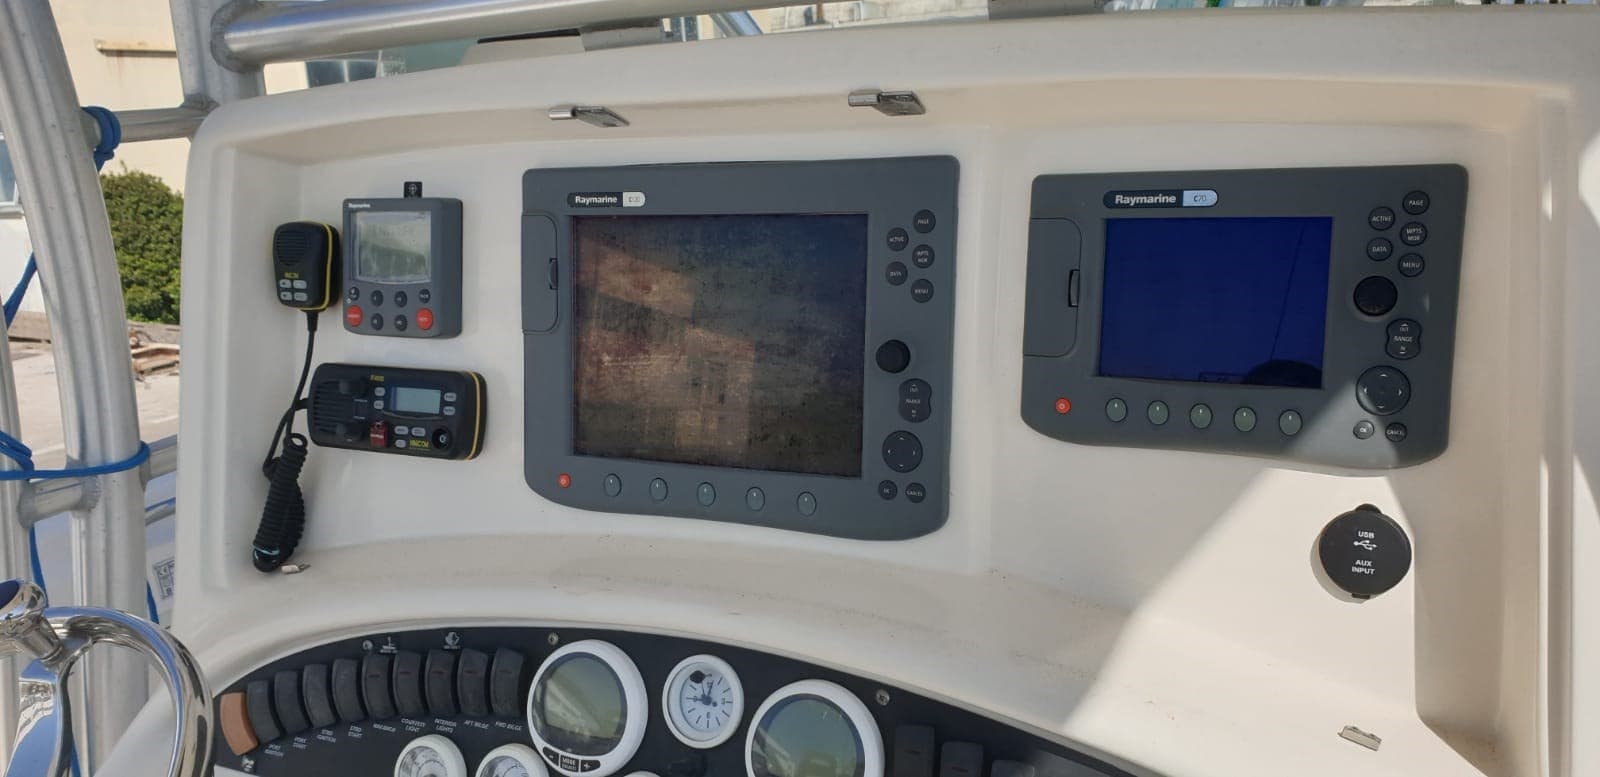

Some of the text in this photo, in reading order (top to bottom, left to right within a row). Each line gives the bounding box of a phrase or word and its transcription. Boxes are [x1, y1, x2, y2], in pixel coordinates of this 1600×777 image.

[575, 195, 618, 206] Raymarine
[1115, 193, 1177, 206] Raymarine
[1358, 530, 1375, 539] USB
[1355, 559, 1373, 567] AUX
[1351, 566, 1376, 575] INPUT
[401, 718, 426, 728] COURTESY
[434, 718, 457, 727] INTERIOR
[474, 721, 489, 730] BILGE
[507, 723, 523, 731] BILGE
[405, 725, 421, 733] LIGHT
[435, 725, 454, 733] LIGHTS
